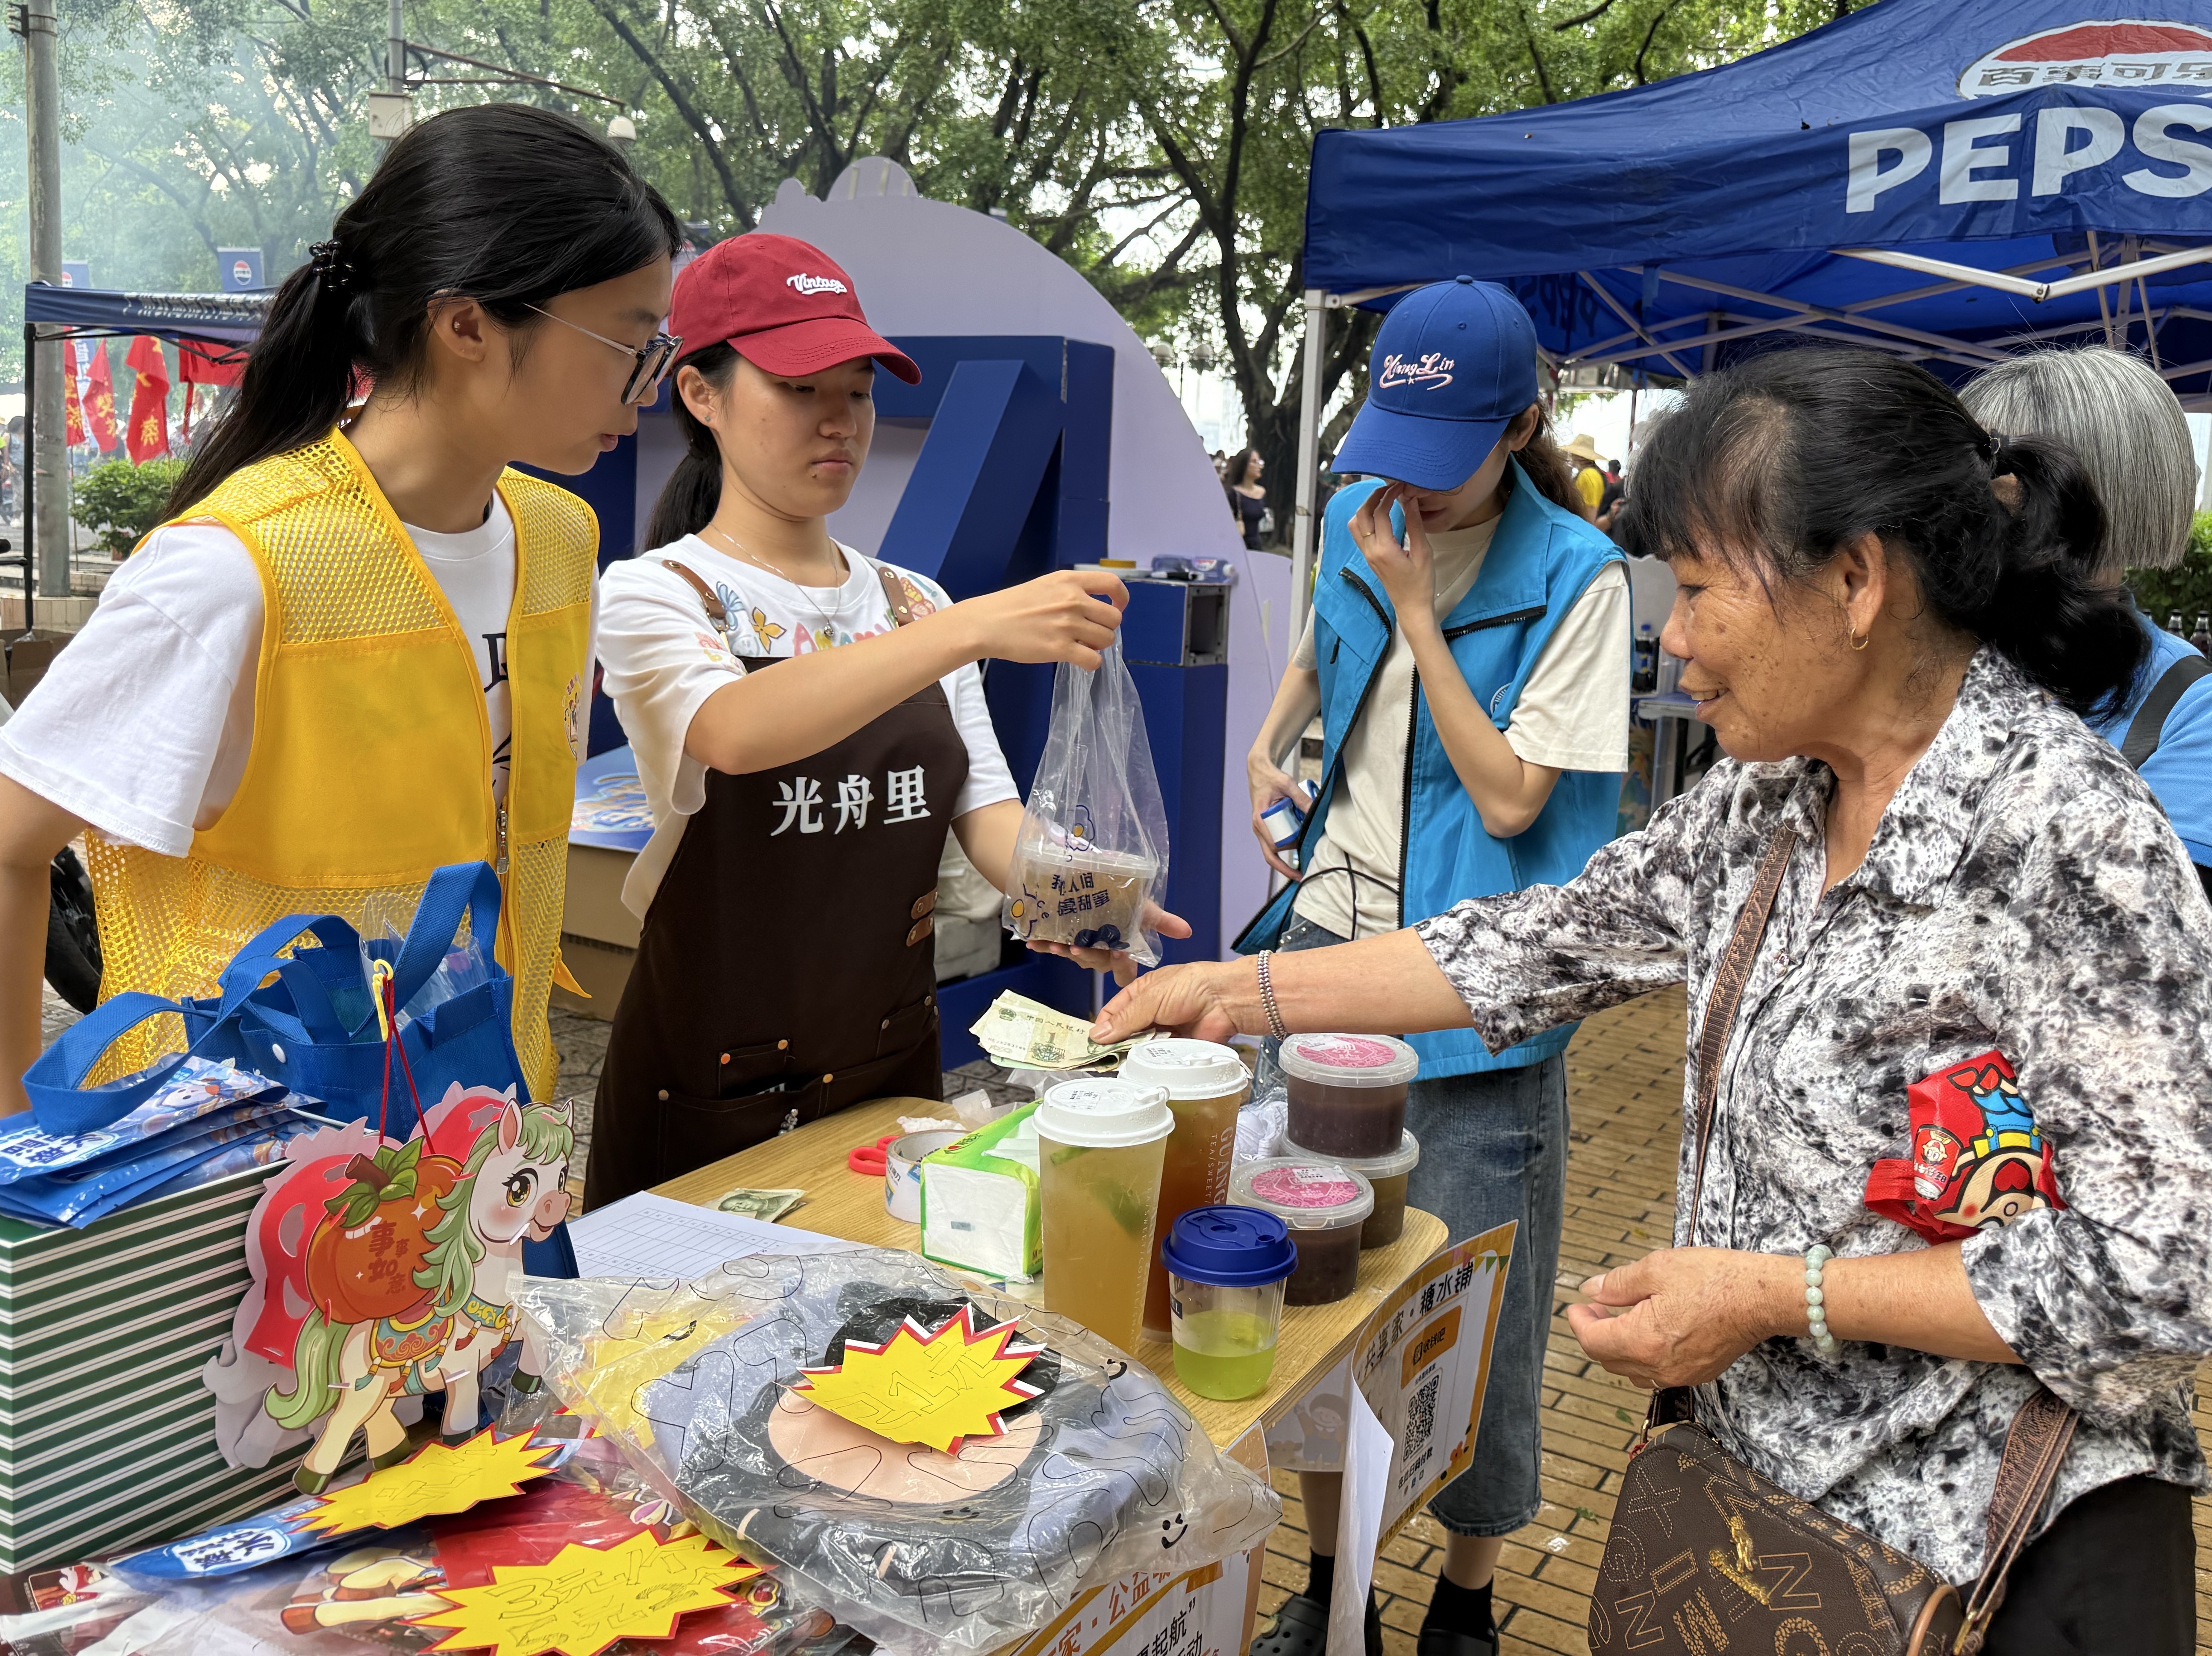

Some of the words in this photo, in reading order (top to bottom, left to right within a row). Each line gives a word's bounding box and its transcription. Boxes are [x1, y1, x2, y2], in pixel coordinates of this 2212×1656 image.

[1846, 103, 2212, 214] PEPS
[770, 765, 931, 837] 光舟里
[1026, 1014, 1086, 1034] 中国人民银行
